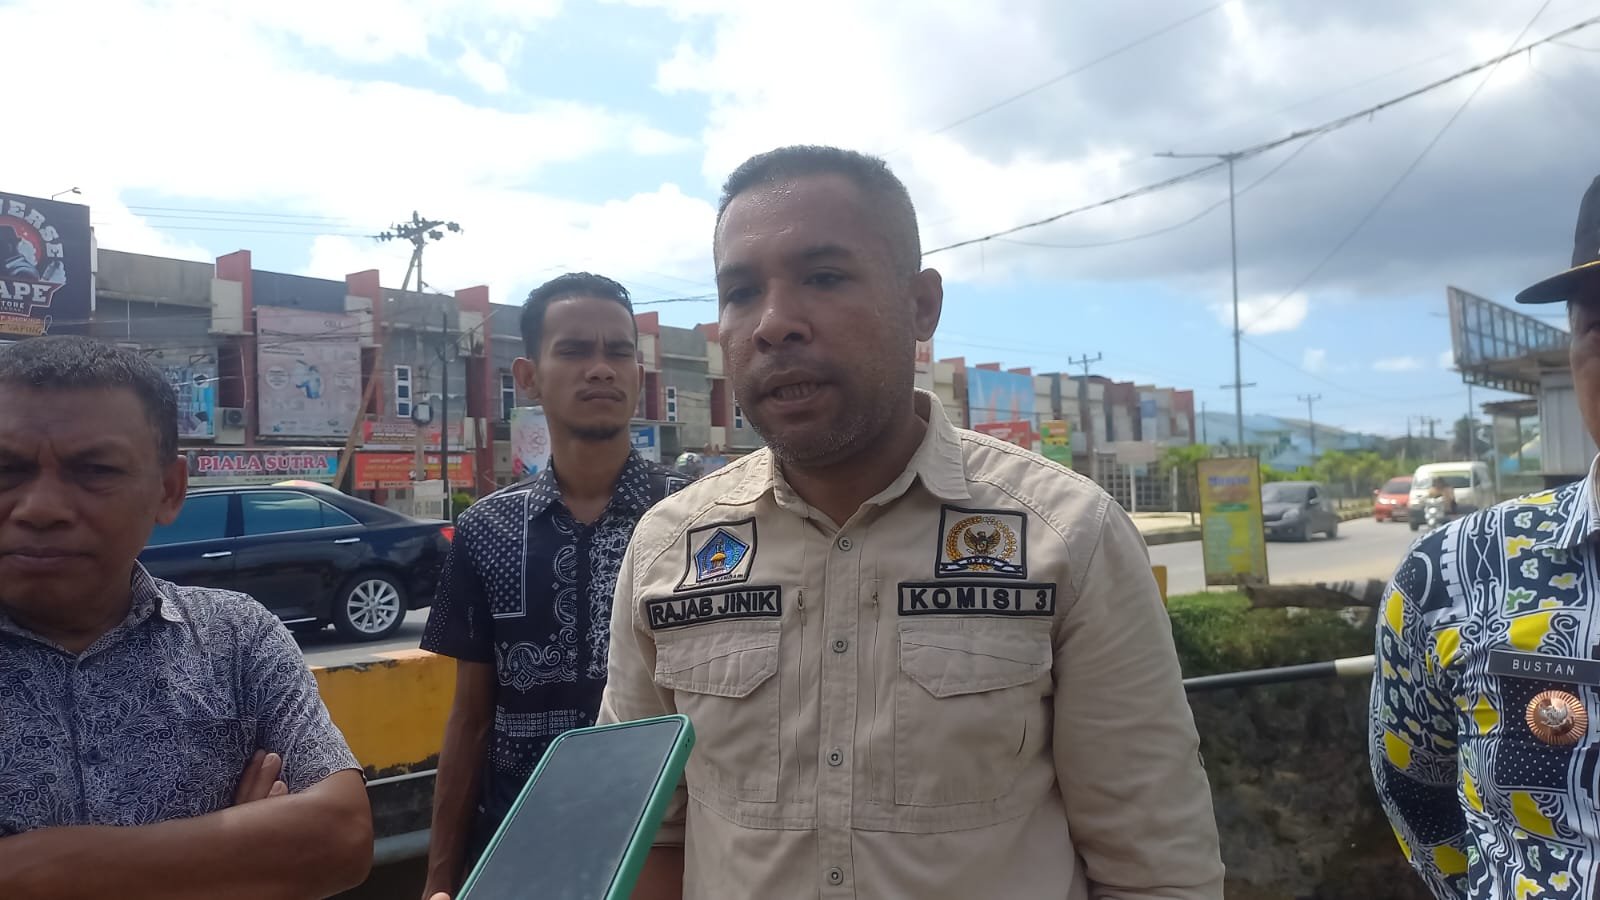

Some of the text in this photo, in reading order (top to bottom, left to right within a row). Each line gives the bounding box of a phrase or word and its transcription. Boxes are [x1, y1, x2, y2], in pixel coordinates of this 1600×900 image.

[199, 454, 328, 472] PIALA SUTRA
[651, 592, 776, 624] RAJAB JINIK
[910, 588, 1048, 610] KOMISI 3
[1512, 659, 1575, 676] BUSTAN
